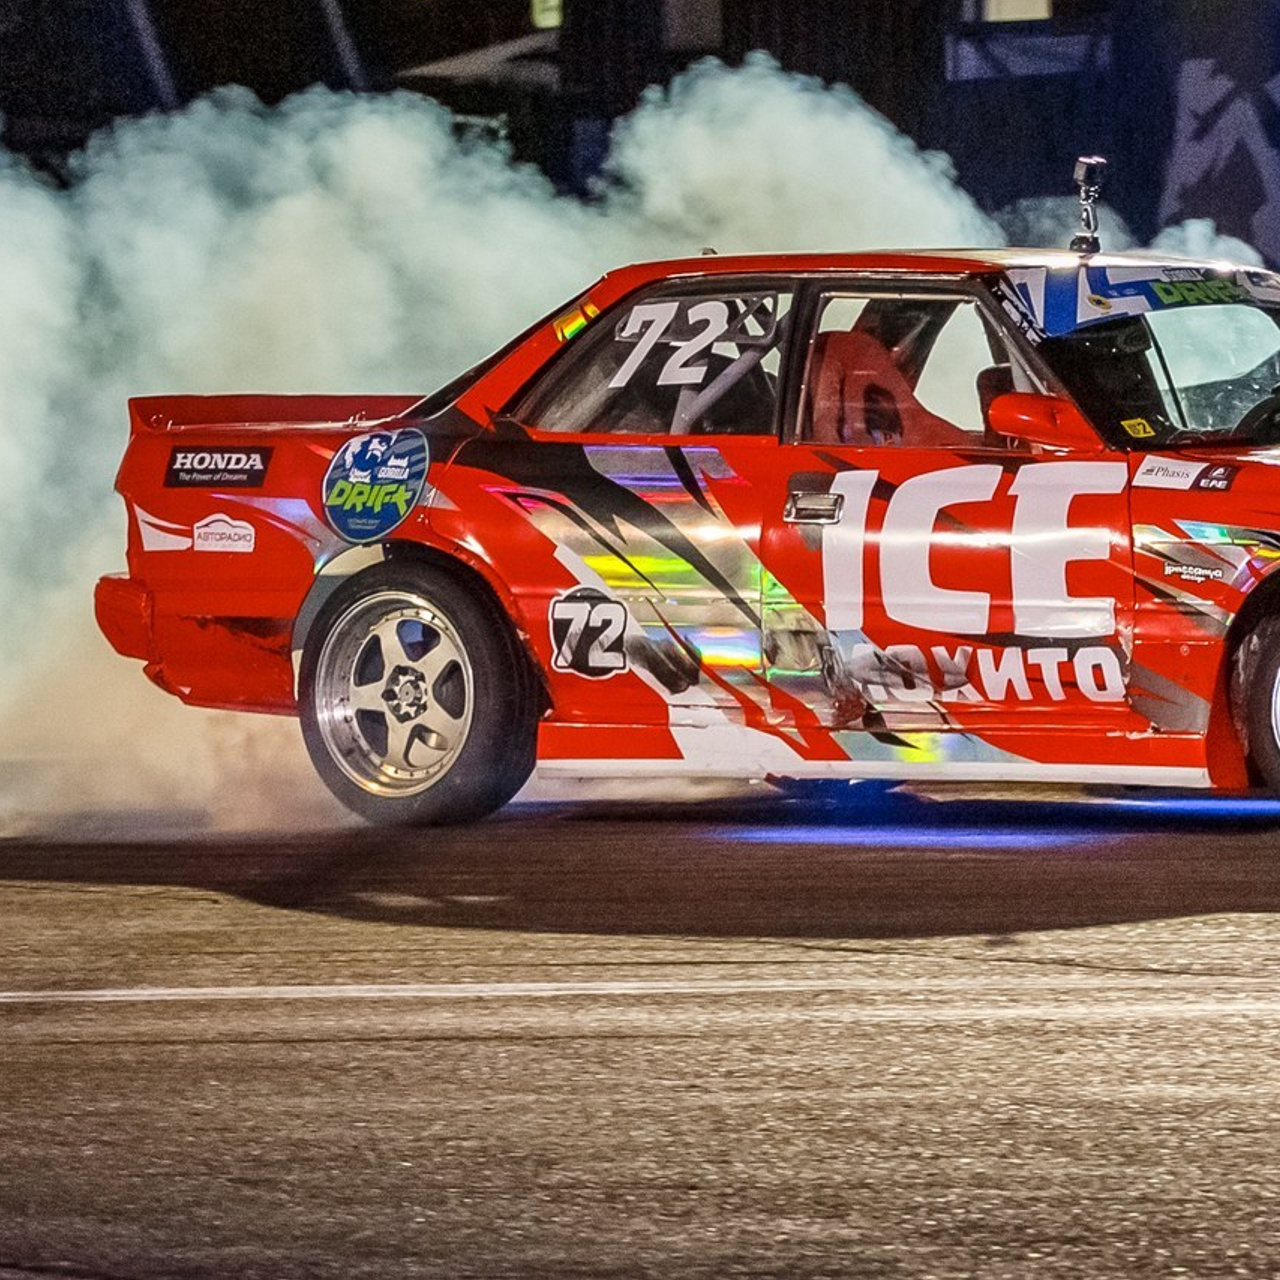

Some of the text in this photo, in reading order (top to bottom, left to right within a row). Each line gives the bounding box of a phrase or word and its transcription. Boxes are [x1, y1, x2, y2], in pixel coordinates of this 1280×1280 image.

[608, 301, 728, 388] 72
[173, 452, 264, 470] HONDA
[326, 480, 413, 516] DRIFT
[196, 532, 253, 543] АВТОРАДИО
[822, 461, 1129, 638] ICE
[552, 602, 625, 668] 72
